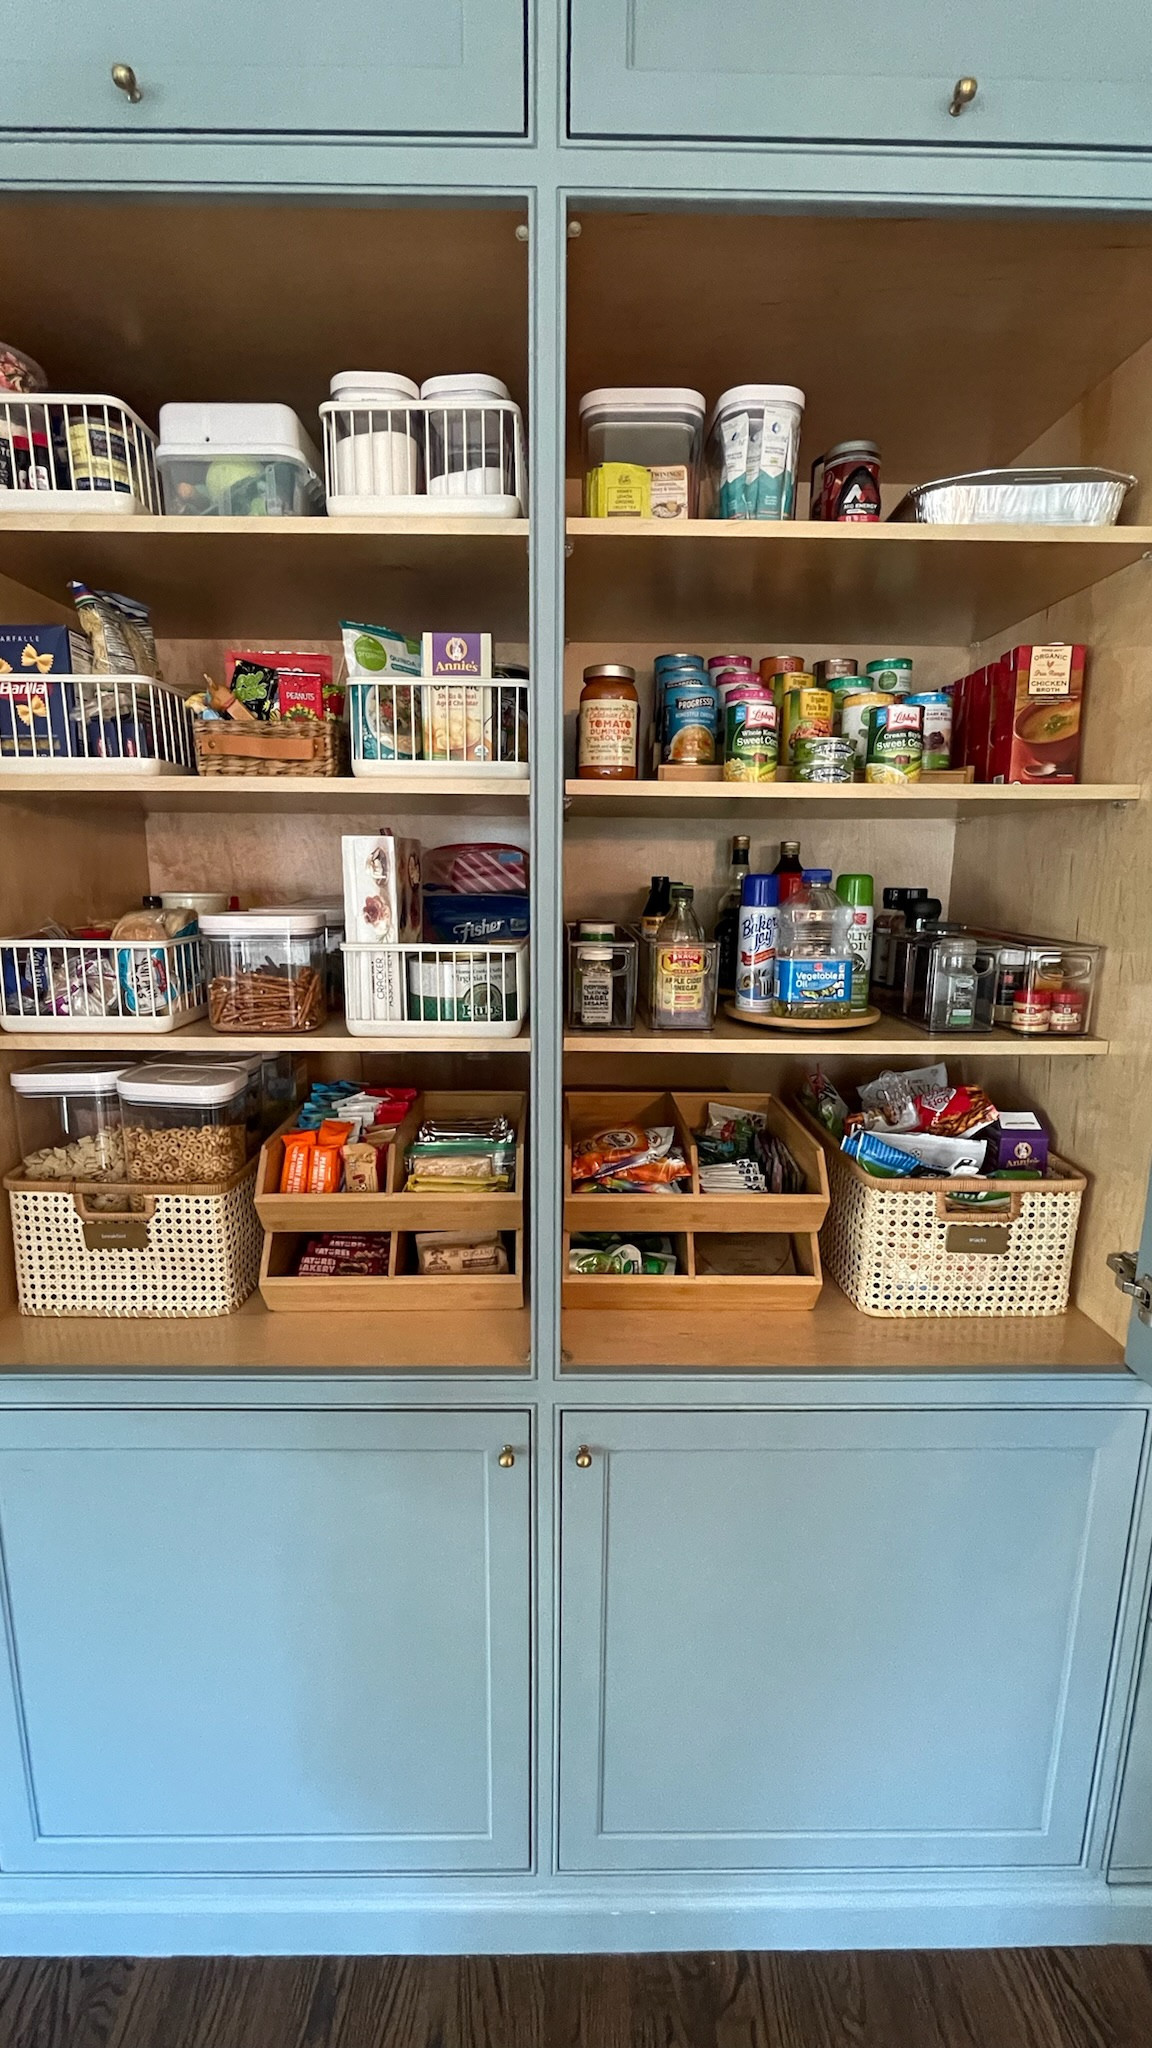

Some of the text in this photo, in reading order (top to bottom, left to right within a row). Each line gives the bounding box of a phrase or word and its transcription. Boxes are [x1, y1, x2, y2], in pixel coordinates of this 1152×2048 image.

[0, 635, 40, 643] ARFALLE
[1034, 653, 1068, 661] ORGANIC
[436, 660, 479, 673] Annie's
[286, 691, 316, 701] PEANUTS
[678, 698, 713, 710] PROGRESSO
[753, 710, 774, 721] Libby's
[896, 712, 918, 723] Libby's
[589, 720, 632, 728] TOMATO
[737, 736, 764, 746] Sweet
[883, 732, 907, 740] Cream
[876, 739, 906, 751] Sweet
[453, 918, 505, 943] Fisher
[375, 957, 385, 1000] CRACKER
[795, 971, 838, 981] Vegetable
[795, 979, 808, 988] Oil
